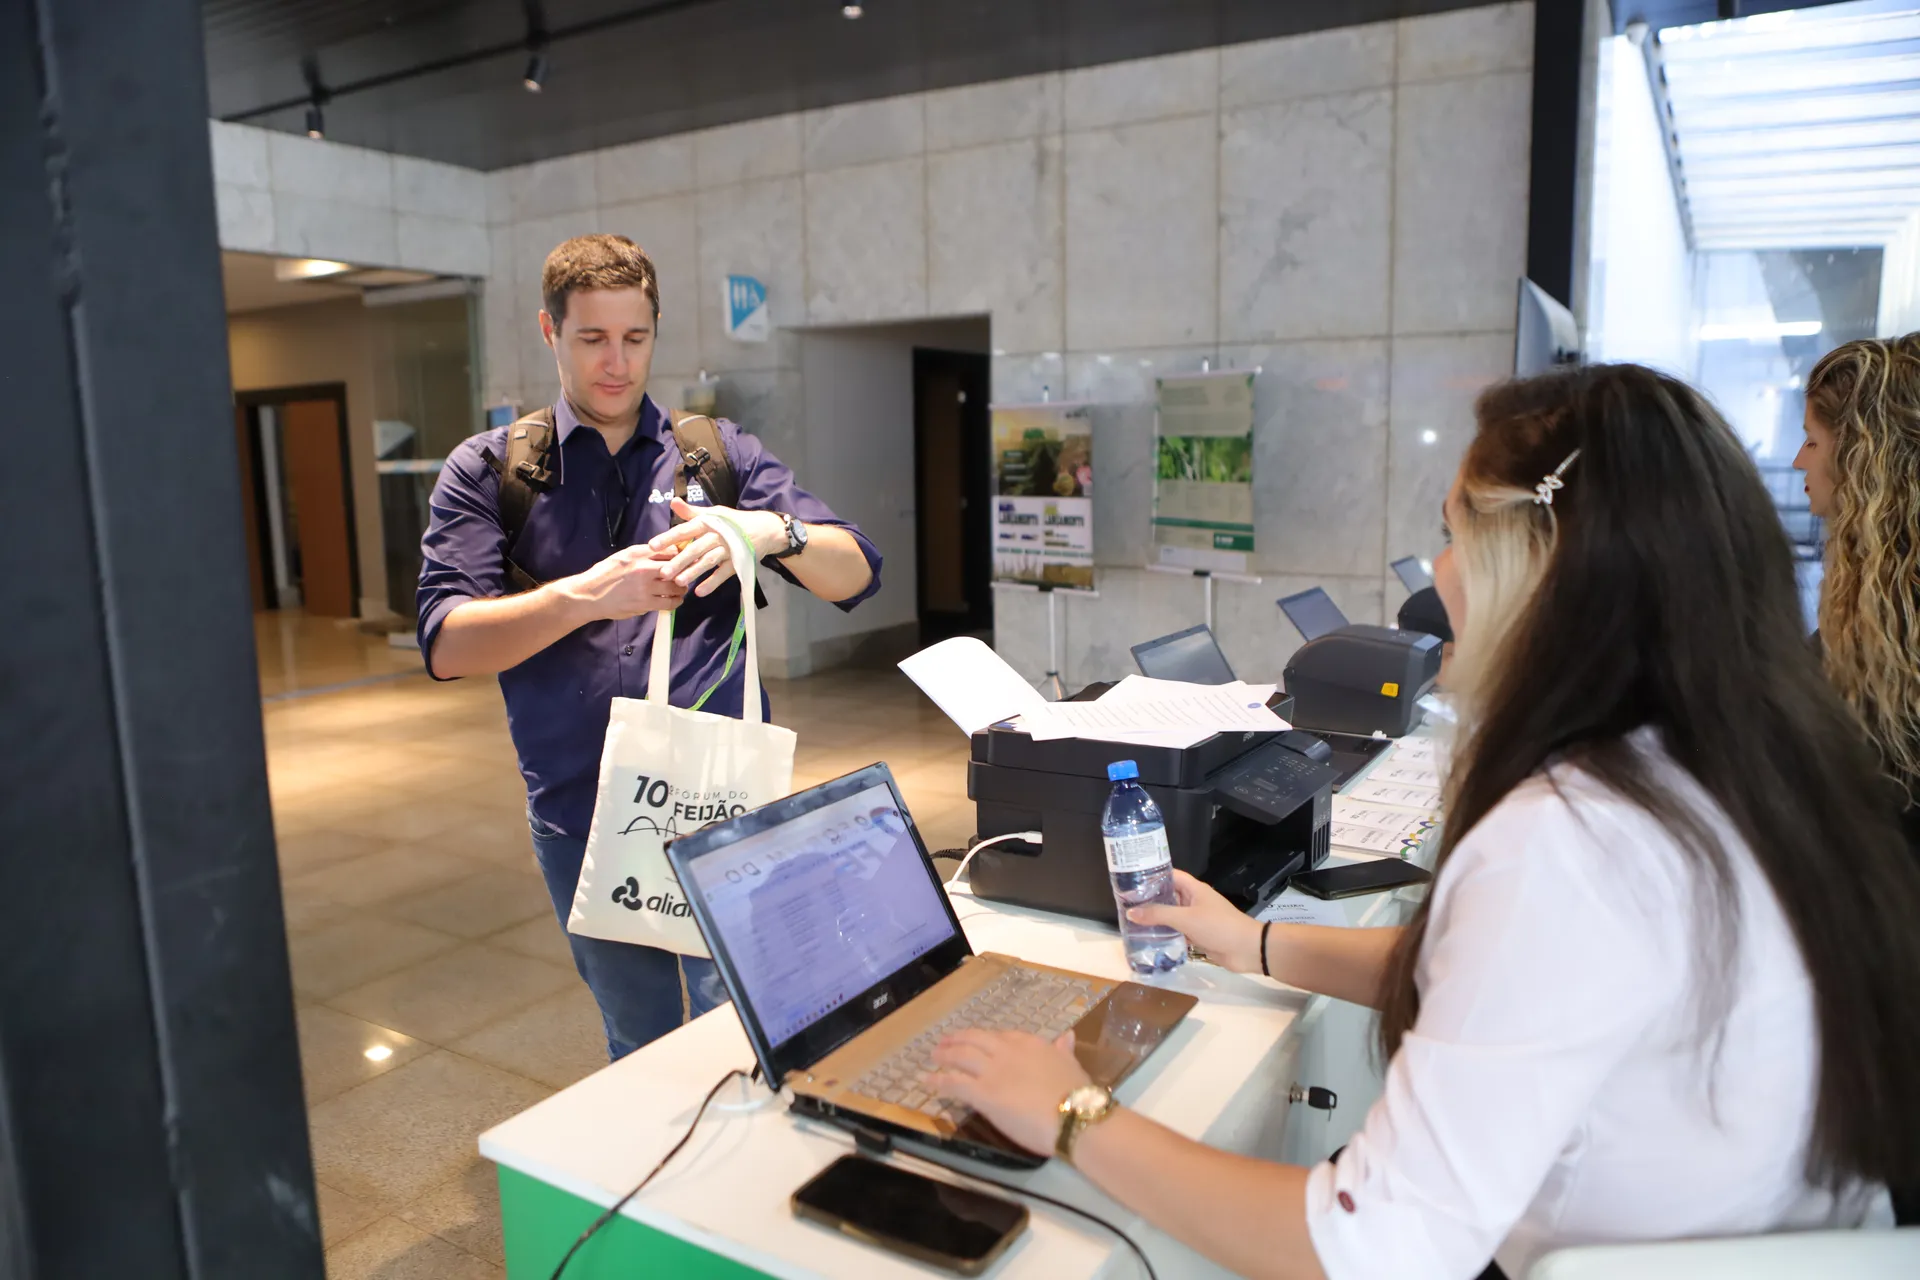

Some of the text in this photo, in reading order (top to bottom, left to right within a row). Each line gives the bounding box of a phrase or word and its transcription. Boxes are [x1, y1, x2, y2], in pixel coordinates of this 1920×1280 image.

[728, 790, 748, 800] DO
[674, 800, 746, 821] FEIJÃO
[646, 892, 692, 917] alia
